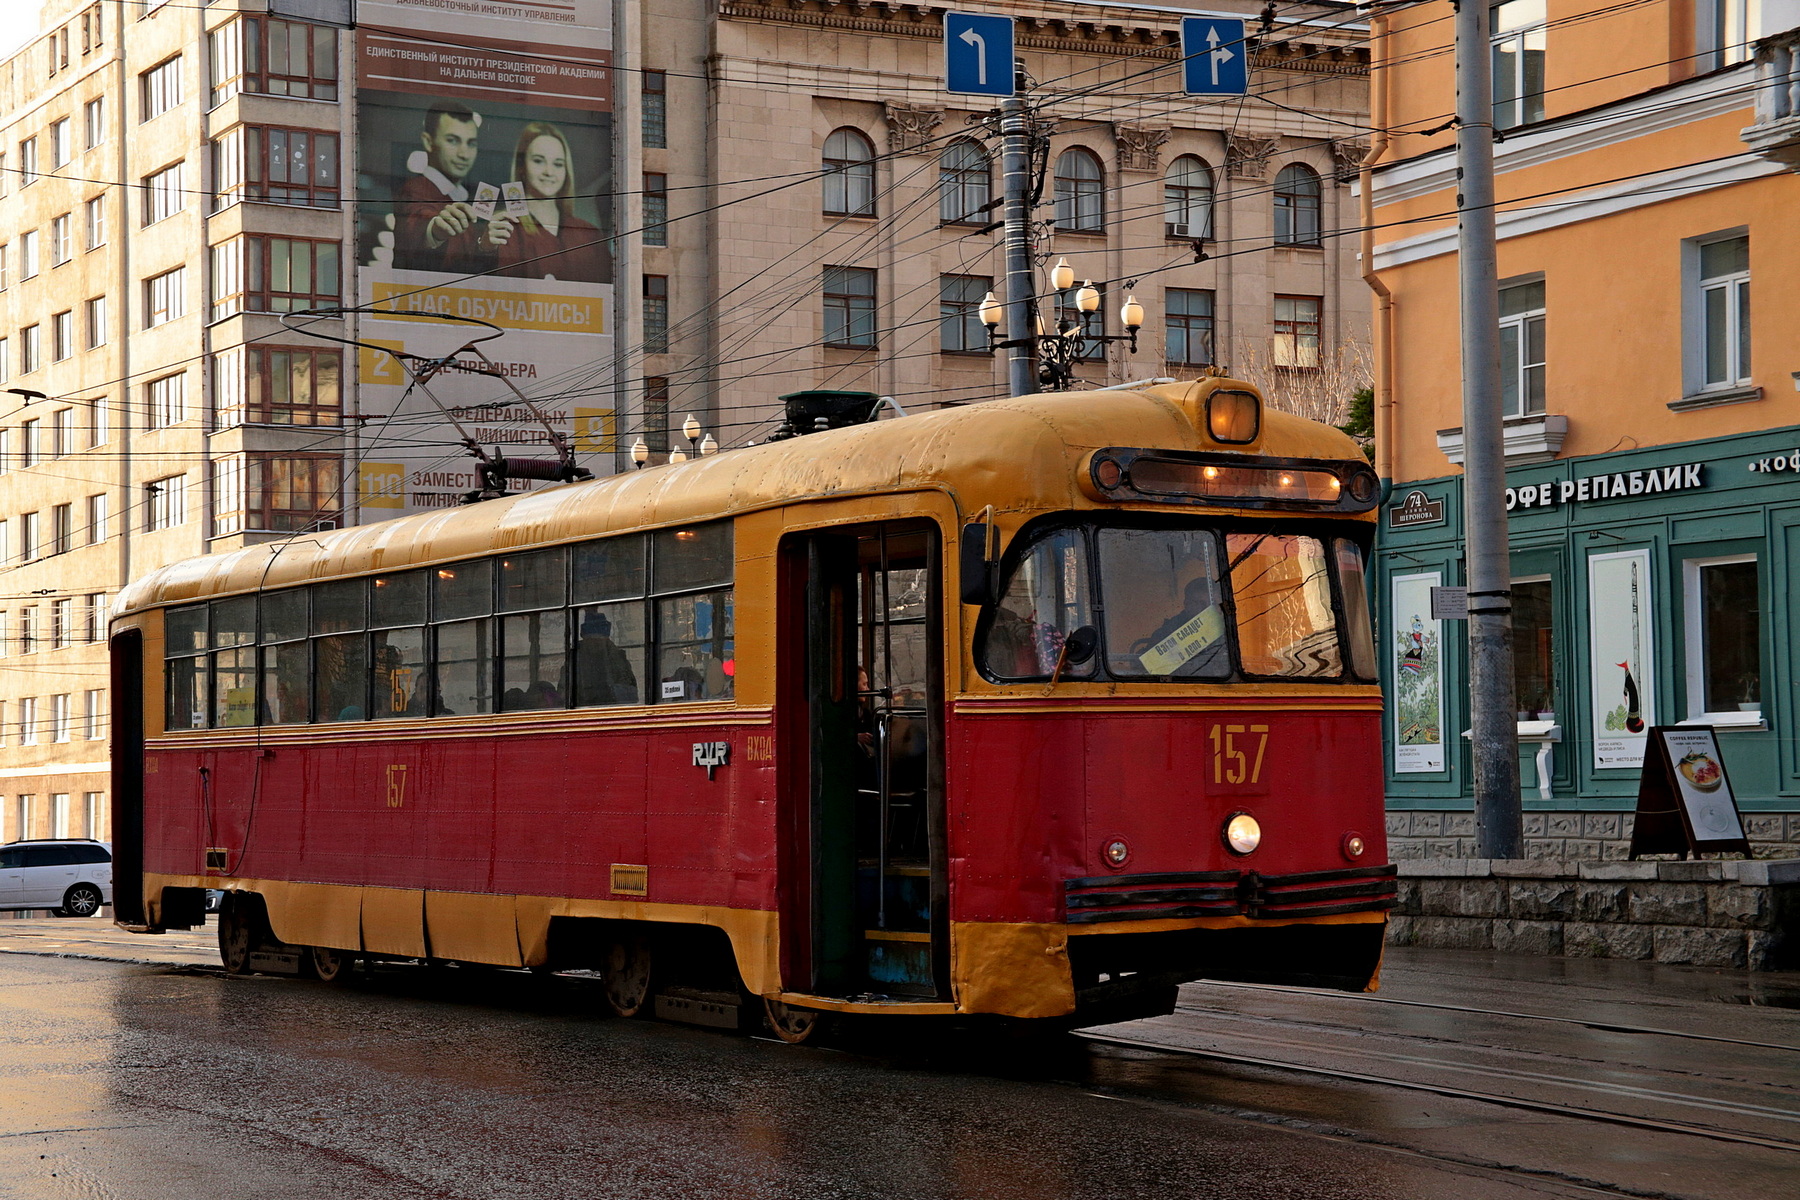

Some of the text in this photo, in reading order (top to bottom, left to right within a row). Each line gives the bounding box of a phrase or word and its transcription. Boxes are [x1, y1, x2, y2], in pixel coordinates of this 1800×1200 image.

[481, 4, 522, 17] ИНСТИТУТ
[525, 9, 576, 22] УПРАВЛЕНИЯ
[366, 46, 606, 80] ЕДИНСТВЕННЫЙ ИНСТИТУТ ПРЕЗИДЕНТСКОЙ АКАДЕМИИ
[440, 66, 536, 85] НА ДАЛЬНЕМ ВОСТОКЕ
[387, 291, 591, 325] У НАС ОБУЧАЛИСЬ!
[372, 350, 390, 377] 2
[451, 405, 567, 425] ФЕДЕРАЛЬНЫХ
[588, 417, 605, 445] 9
[1505, 463, 1702, 511] ОФЕ РЕПАБЛИК
[1409, 494, 1422, 508] 74
[1399, 512, 1433, 522] ШЕРОНОВА
[390, 668, 412, 712] 157
[747, 736, 773, 761] ВХОД
[1209, 724, 1270, 784] 157
[386, 764, 407, 808] 157
